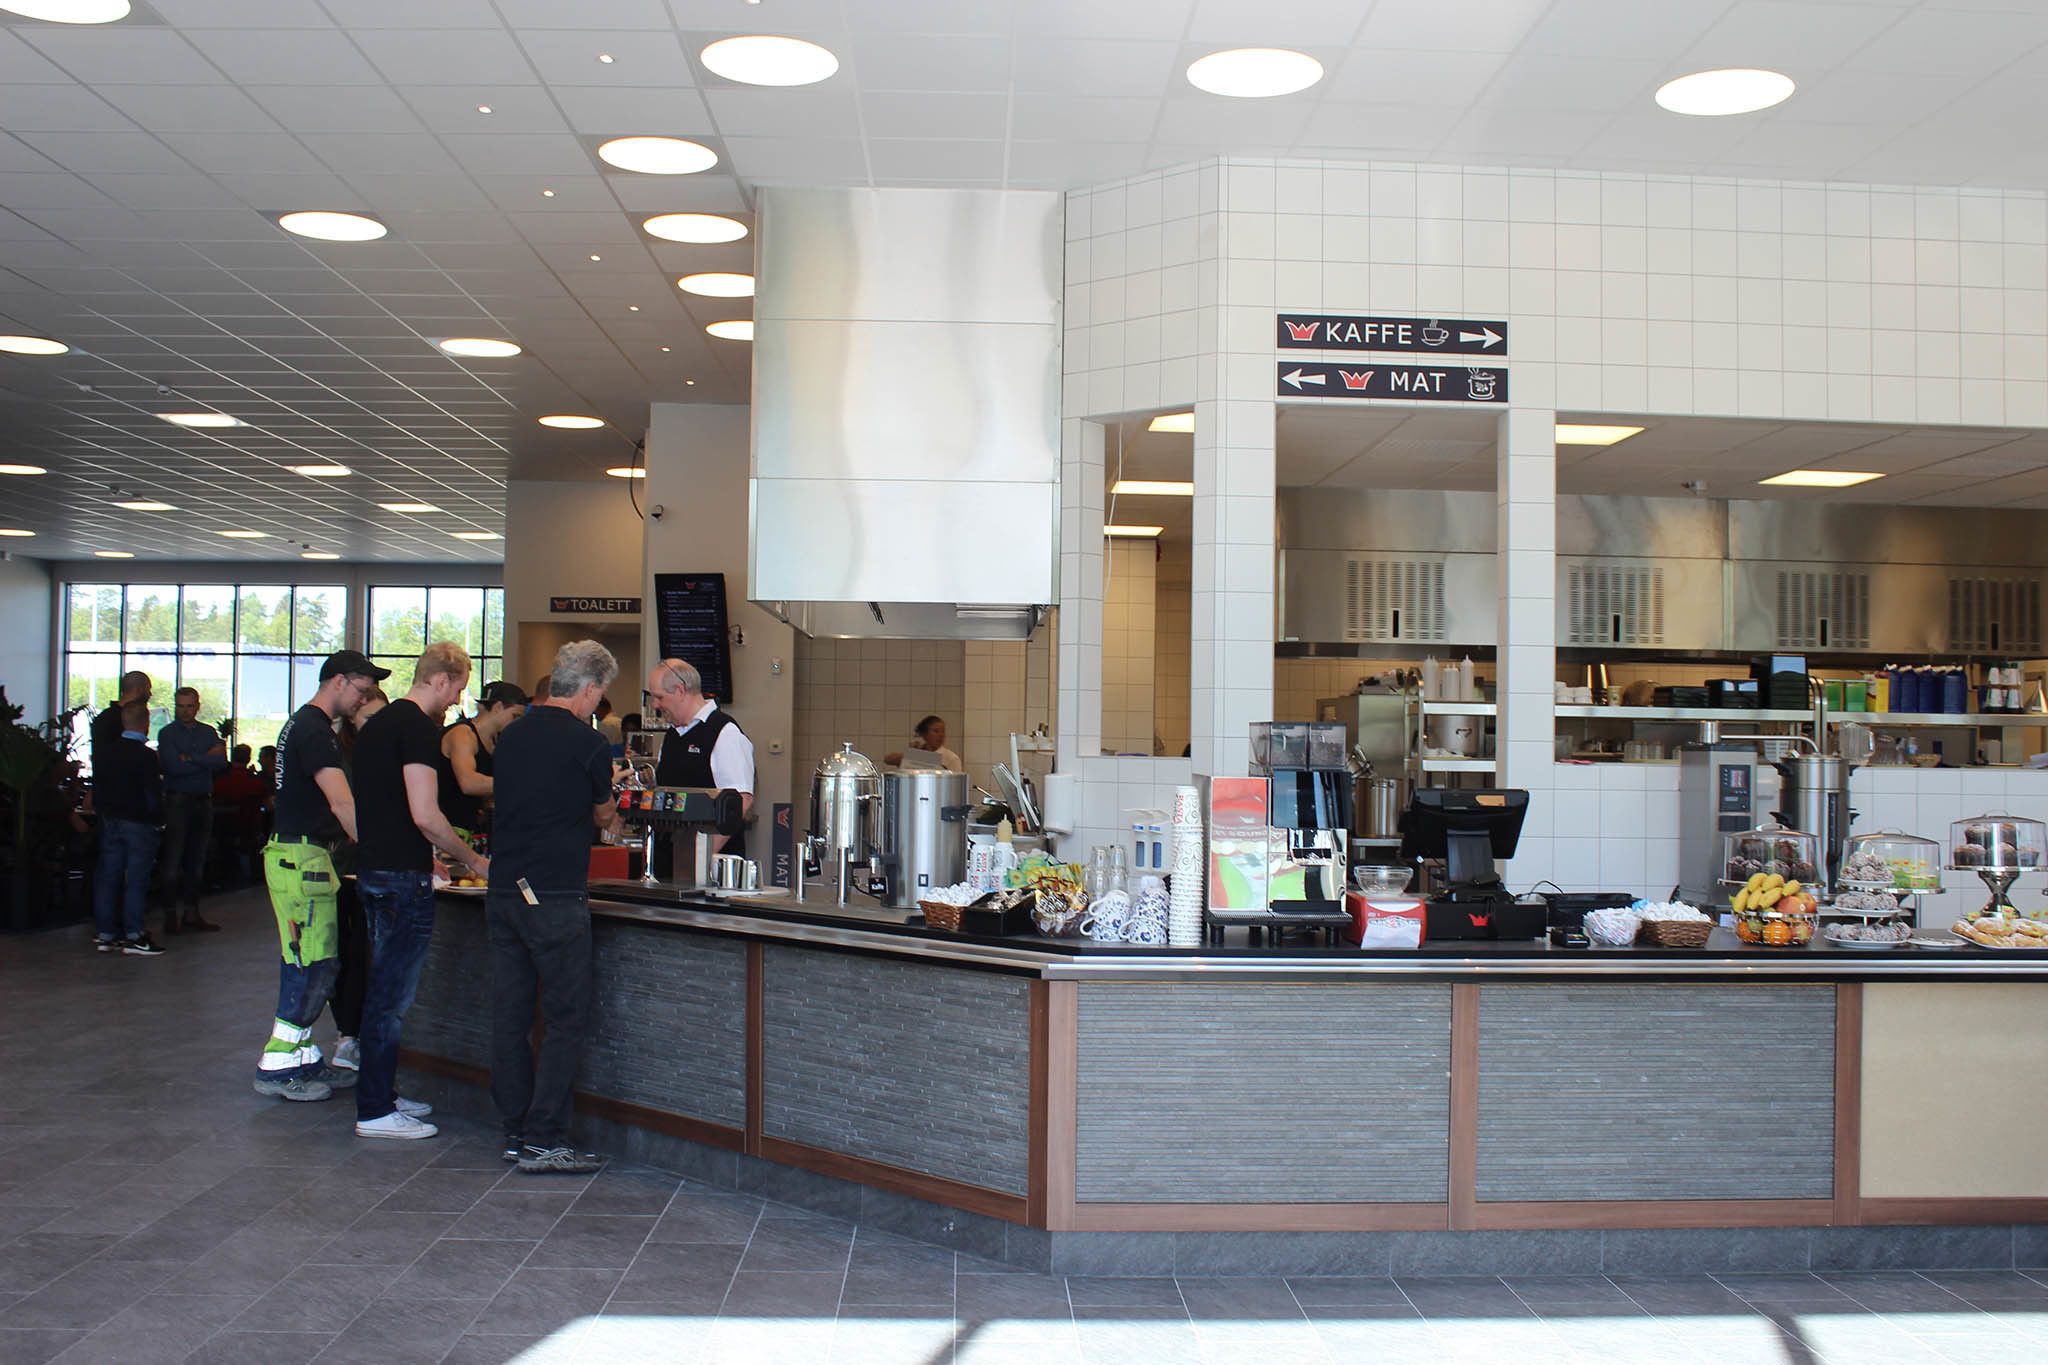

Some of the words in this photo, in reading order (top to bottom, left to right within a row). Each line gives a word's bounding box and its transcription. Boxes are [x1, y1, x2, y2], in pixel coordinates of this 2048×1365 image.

[1326, 322, 1412, 344] KAFFE
[1390, 371, 1446, 392] MAT
[571, 600, 632, 611] TOALETT
[776, 854, 789, 887] MAT
